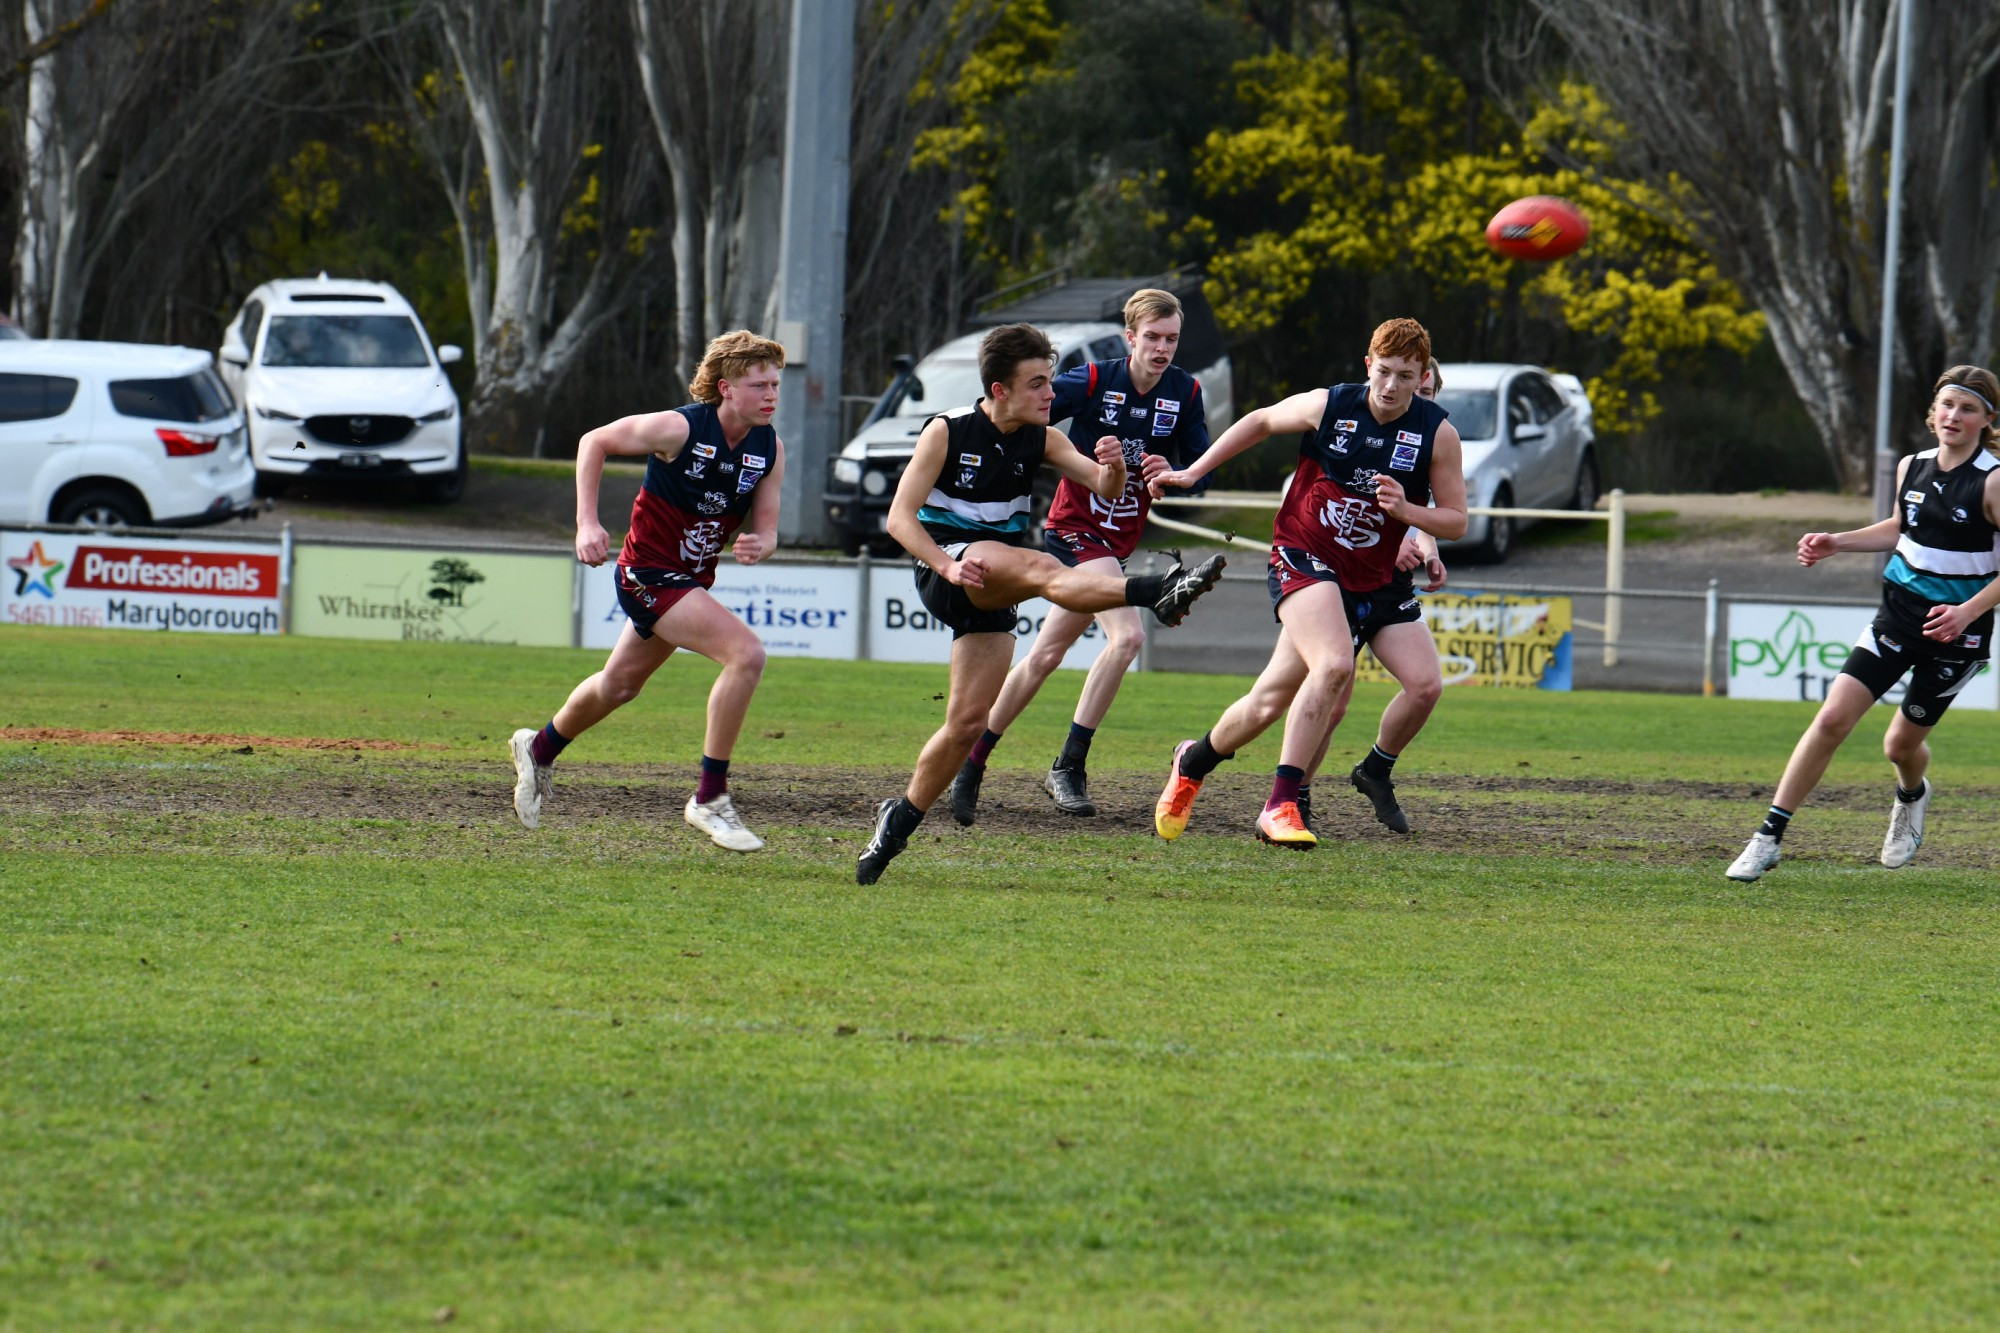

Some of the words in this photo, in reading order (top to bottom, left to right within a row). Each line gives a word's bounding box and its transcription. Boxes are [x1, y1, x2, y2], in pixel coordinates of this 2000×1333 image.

[84, 552, 260, 591] Professionals
[7, 603, 56, 625] 5461
[108, 598, 278, 635] Maryborough
[318, 594, 443, 622] Whirrakee
[402, 622, 445, 641] Rise
